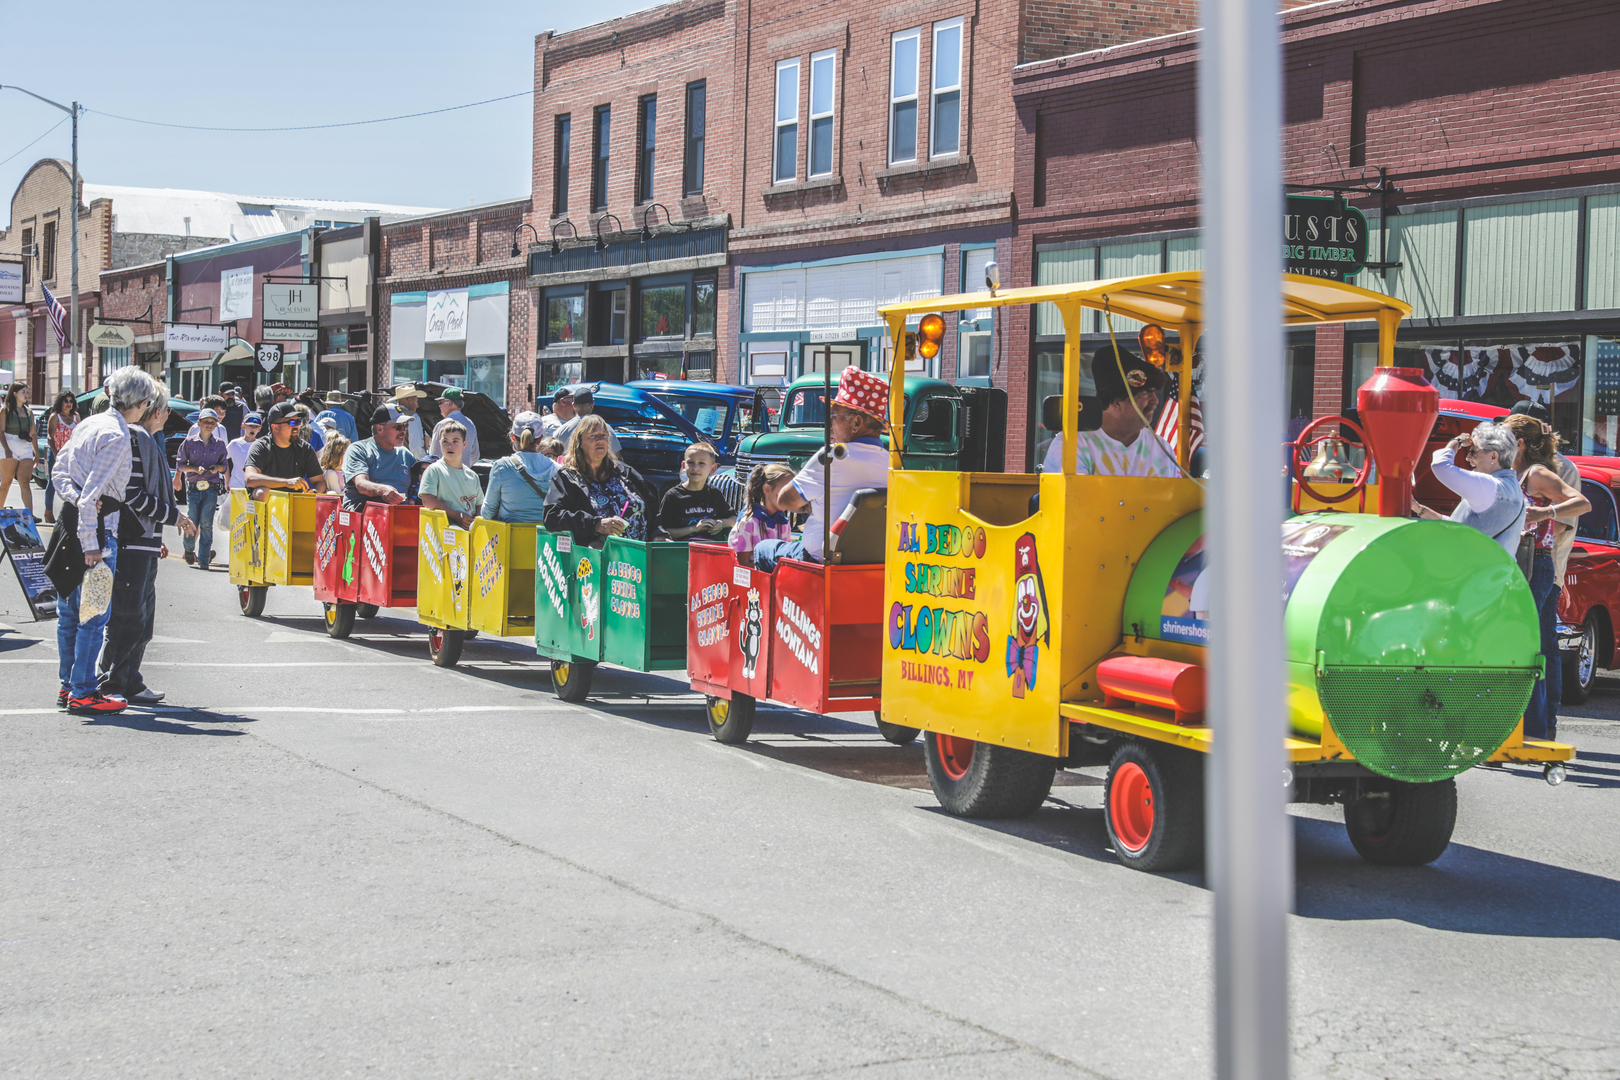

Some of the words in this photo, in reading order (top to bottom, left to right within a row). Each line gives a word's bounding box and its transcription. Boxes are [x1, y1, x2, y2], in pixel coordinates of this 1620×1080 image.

[1283, 214, 1358, 243] USTS
[1282, 244, 1305, 259] BIG
[1308, 246, 1356, 262] TIMBER
[1309, 267, 1329, 277] 1908
[168, 332, 179, 341] Two
[180, 332, 201, 342] Rivers
[201, 334, 225, 345] Gallery
[429, 313, 446, 339] Crazy
[260, 351, 279, 361] 298
[367, 520, 387, 566] BILLINGS
[897, 521, 921, 554] AL
[925, 523, 987, 559] BEDOO
[363, 532, 384, 584] MONTANA
[420, 535, 442, 584] MONTANA
[474, 556, 482, 574] AL
[479, 551, 498, 584] SHRINE
[542, 541, 568, 599] BILLINGS
[607, 561, 617, 576] AL
[617, 561, 642, 584] BEDOO
[481, 561, 503, 598] CLOWNS
[538, 554, 564, 618] MONTANA
[611, 579, 637, 600] SHRINE
[905, 561, 976, 601] SHRINE
[610, 596, 640, 619] CLOWNS
[691, 592, 702, 612] AL
[701, 582, 729, 606] BEDOO
[696, 602, 725, 628] SHRINE
[781, 596, 821, 650] BILLINGS
[776, 616, 819, 675] MONTANA
[889, 601, 991, 663] CLOWNS
[901, 660, 953, 691] BILLINGS,
[957, 669, 975, 691] MT
